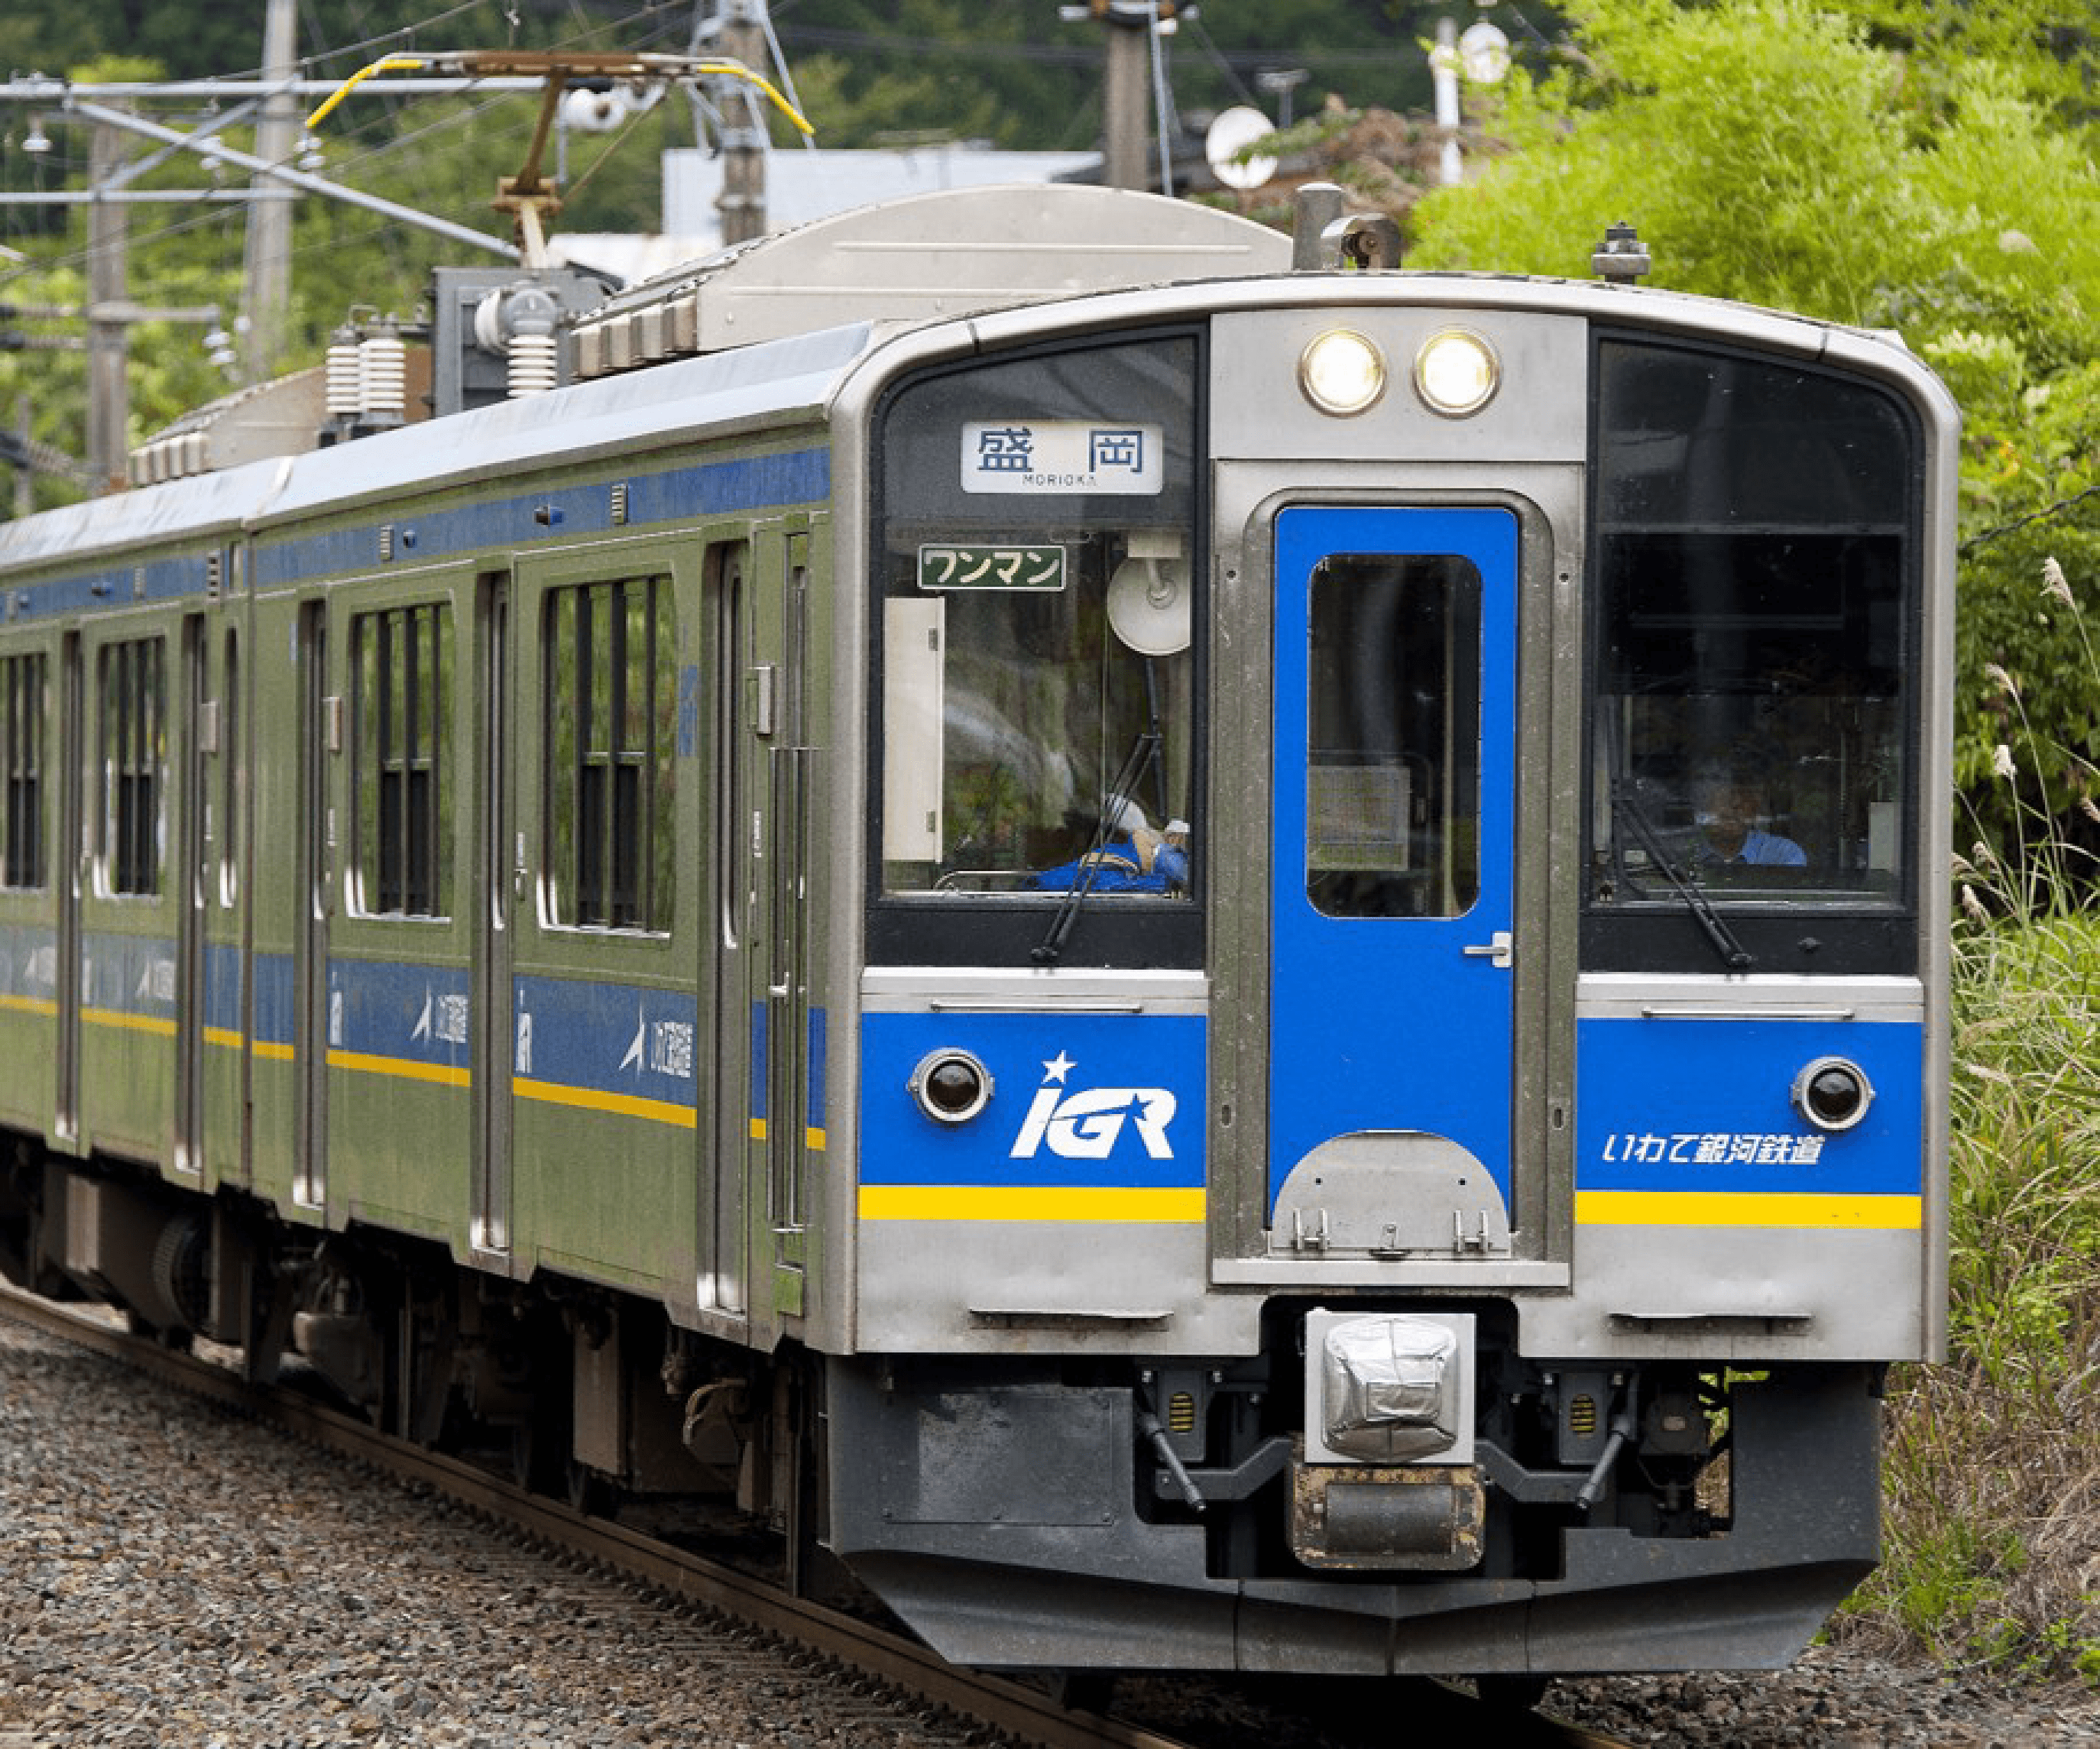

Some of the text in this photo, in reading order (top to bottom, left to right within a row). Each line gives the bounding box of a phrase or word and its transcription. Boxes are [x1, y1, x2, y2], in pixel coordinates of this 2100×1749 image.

[977, 426, 1143, 473] 盛岡
[1022, 474, 1097, 487] MORIOKA
[924, 550, 1059, 585] ワンマン
[1602, 1132, 1825, 1164] いわて銀河鉄道
